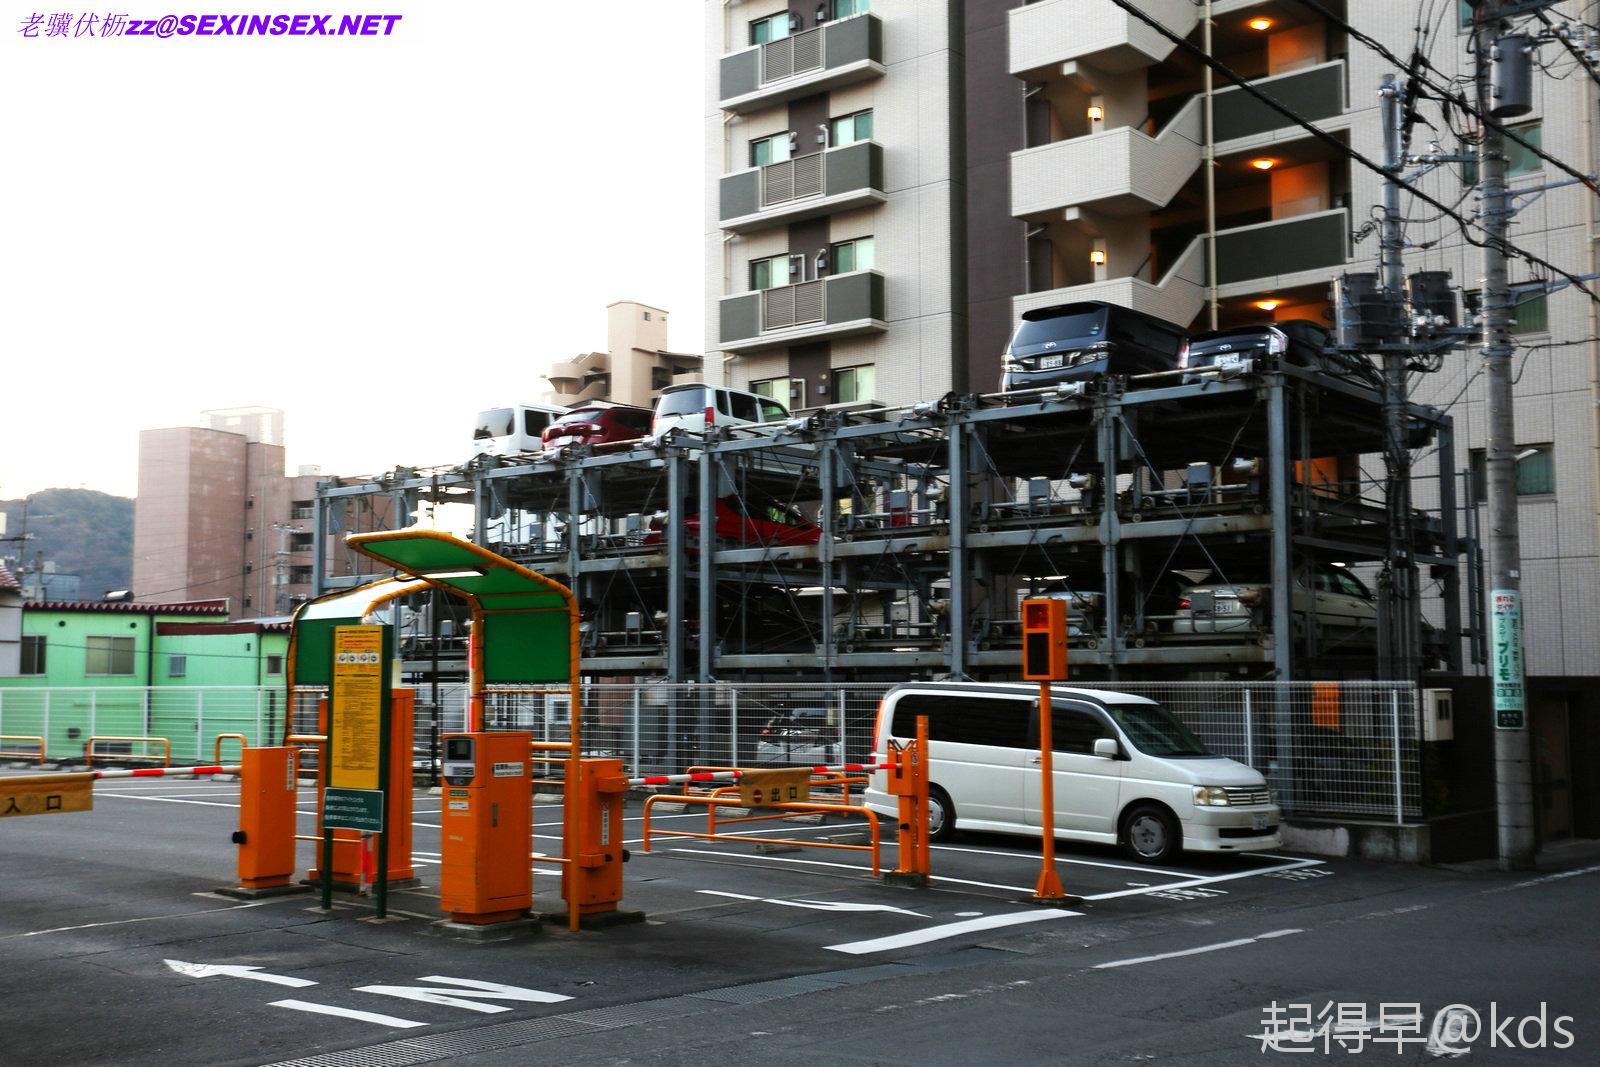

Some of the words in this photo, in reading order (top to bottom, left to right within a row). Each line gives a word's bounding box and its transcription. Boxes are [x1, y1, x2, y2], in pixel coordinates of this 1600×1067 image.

[771, 787, 797, 802] 出口
[5, 795, 61, 814] 入口
[267, 975, 576, 1028] IN
